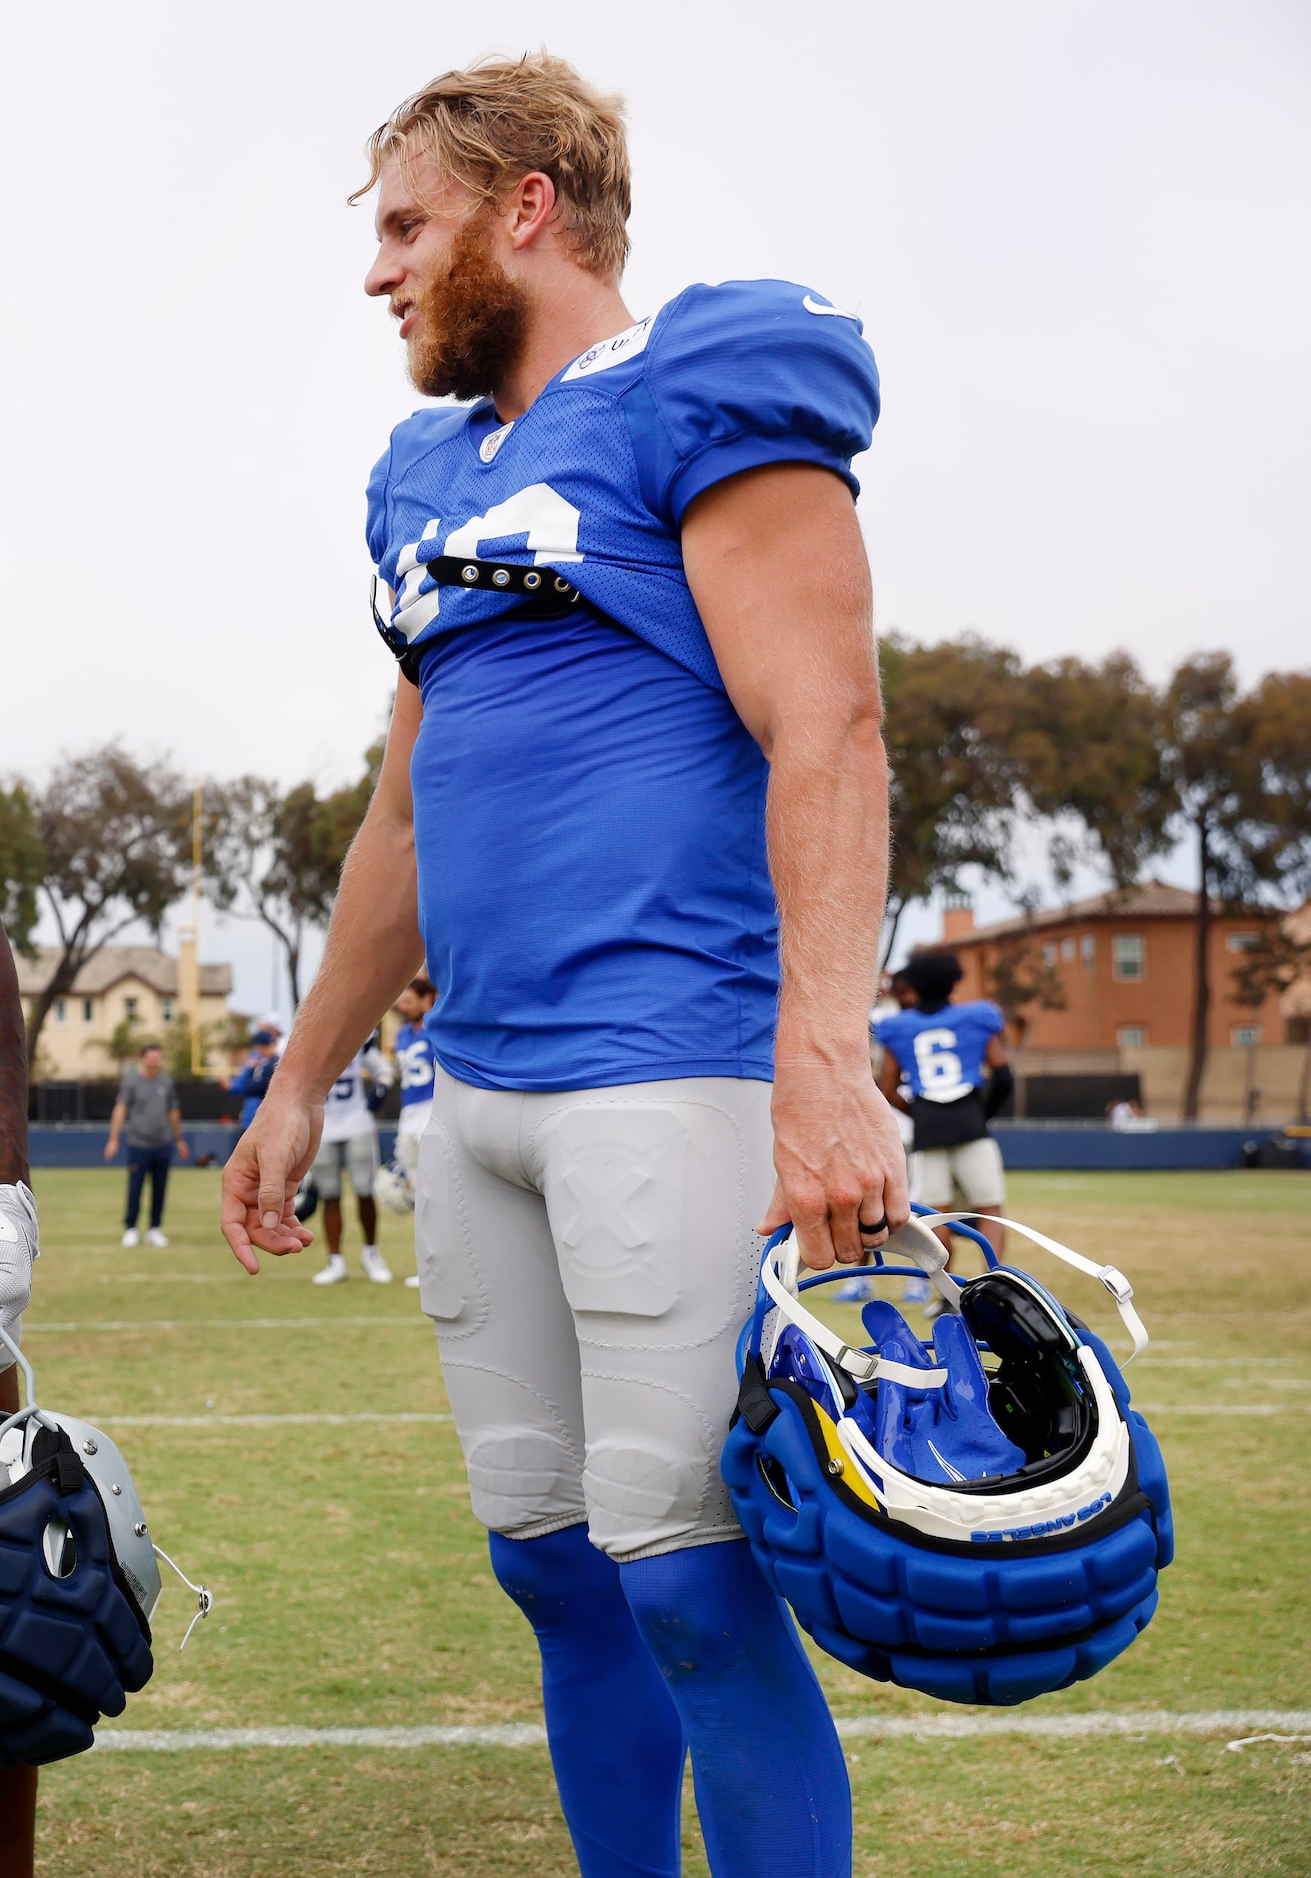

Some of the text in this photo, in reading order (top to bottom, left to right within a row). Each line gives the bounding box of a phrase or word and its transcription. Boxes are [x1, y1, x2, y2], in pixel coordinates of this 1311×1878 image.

[913, 1027, 963, 1080] 6
[970, 1491, 1113, 1543] LOS ANGELES
